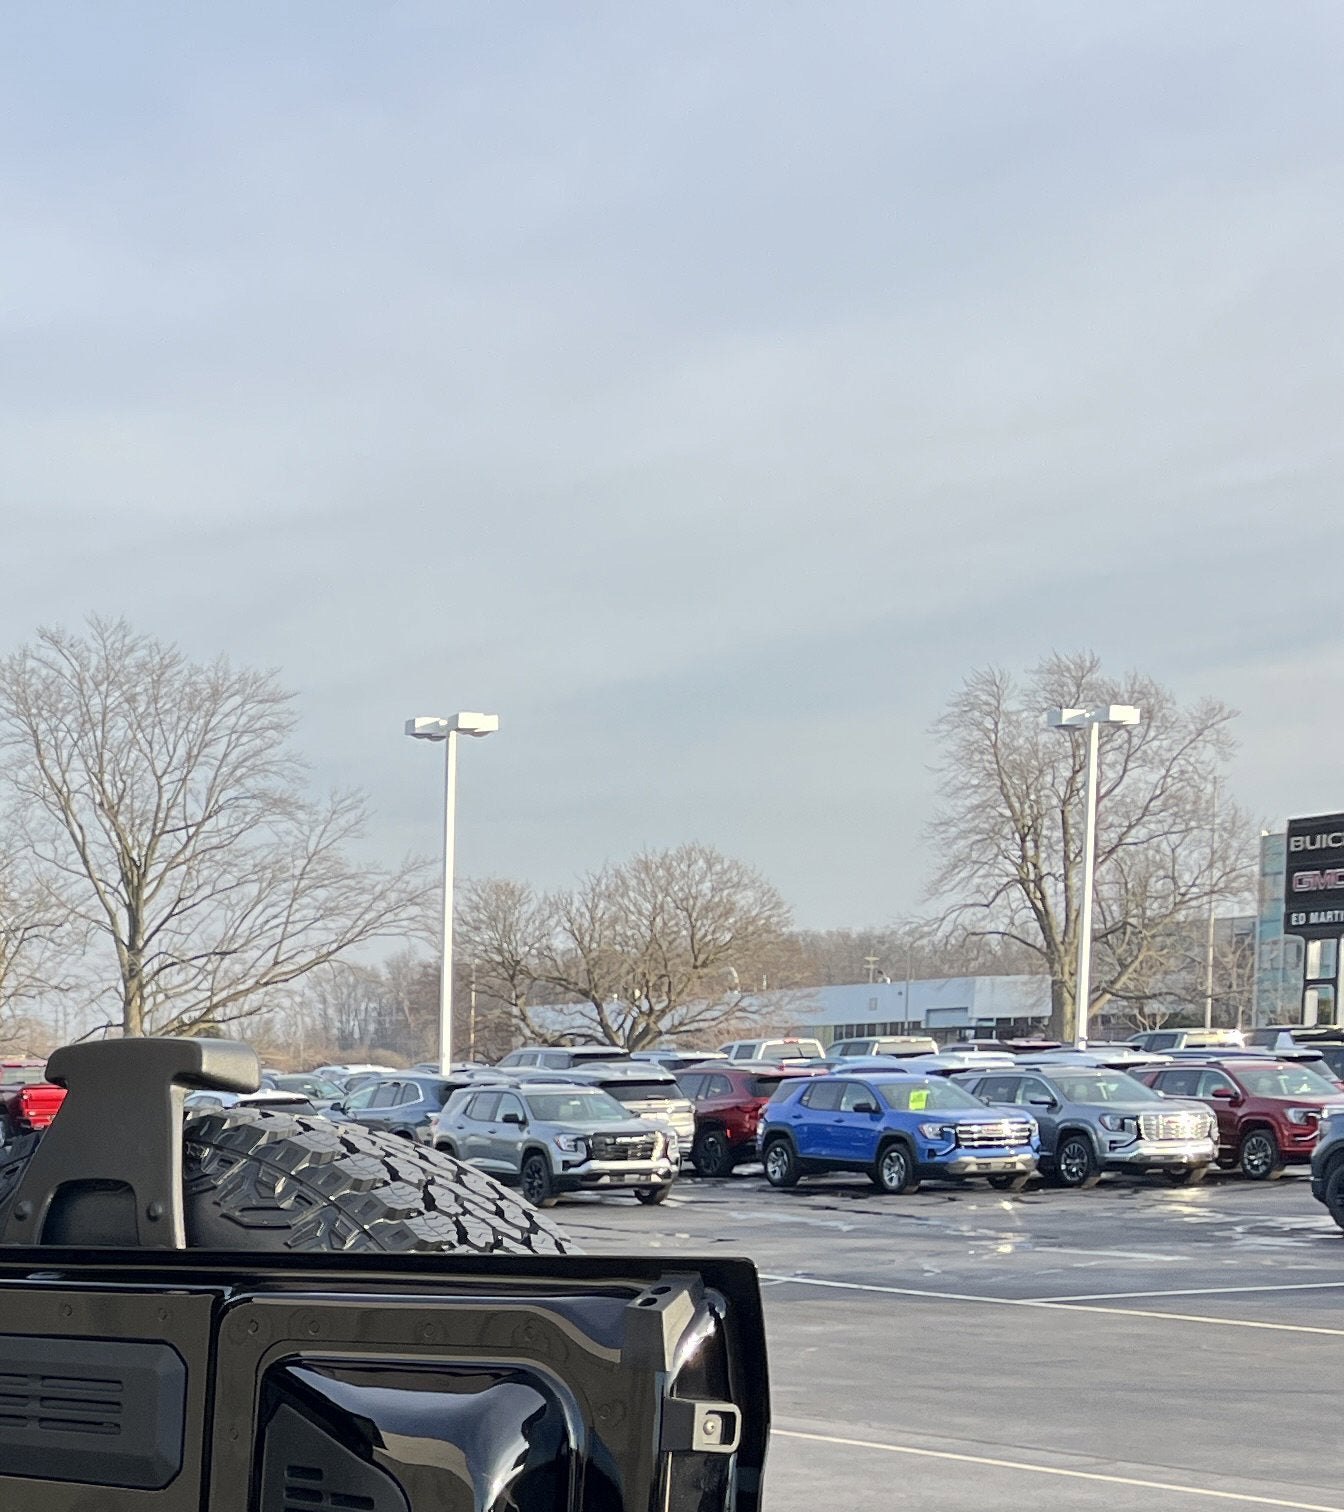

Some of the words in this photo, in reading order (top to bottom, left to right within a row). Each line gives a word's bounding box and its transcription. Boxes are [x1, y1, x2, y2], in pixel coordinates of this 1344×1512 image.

[1290, 832, 1344, 851] BUIC
[1291, 912, 1306, 926] ED
[1309, 910, 1344, 924] MARTI
